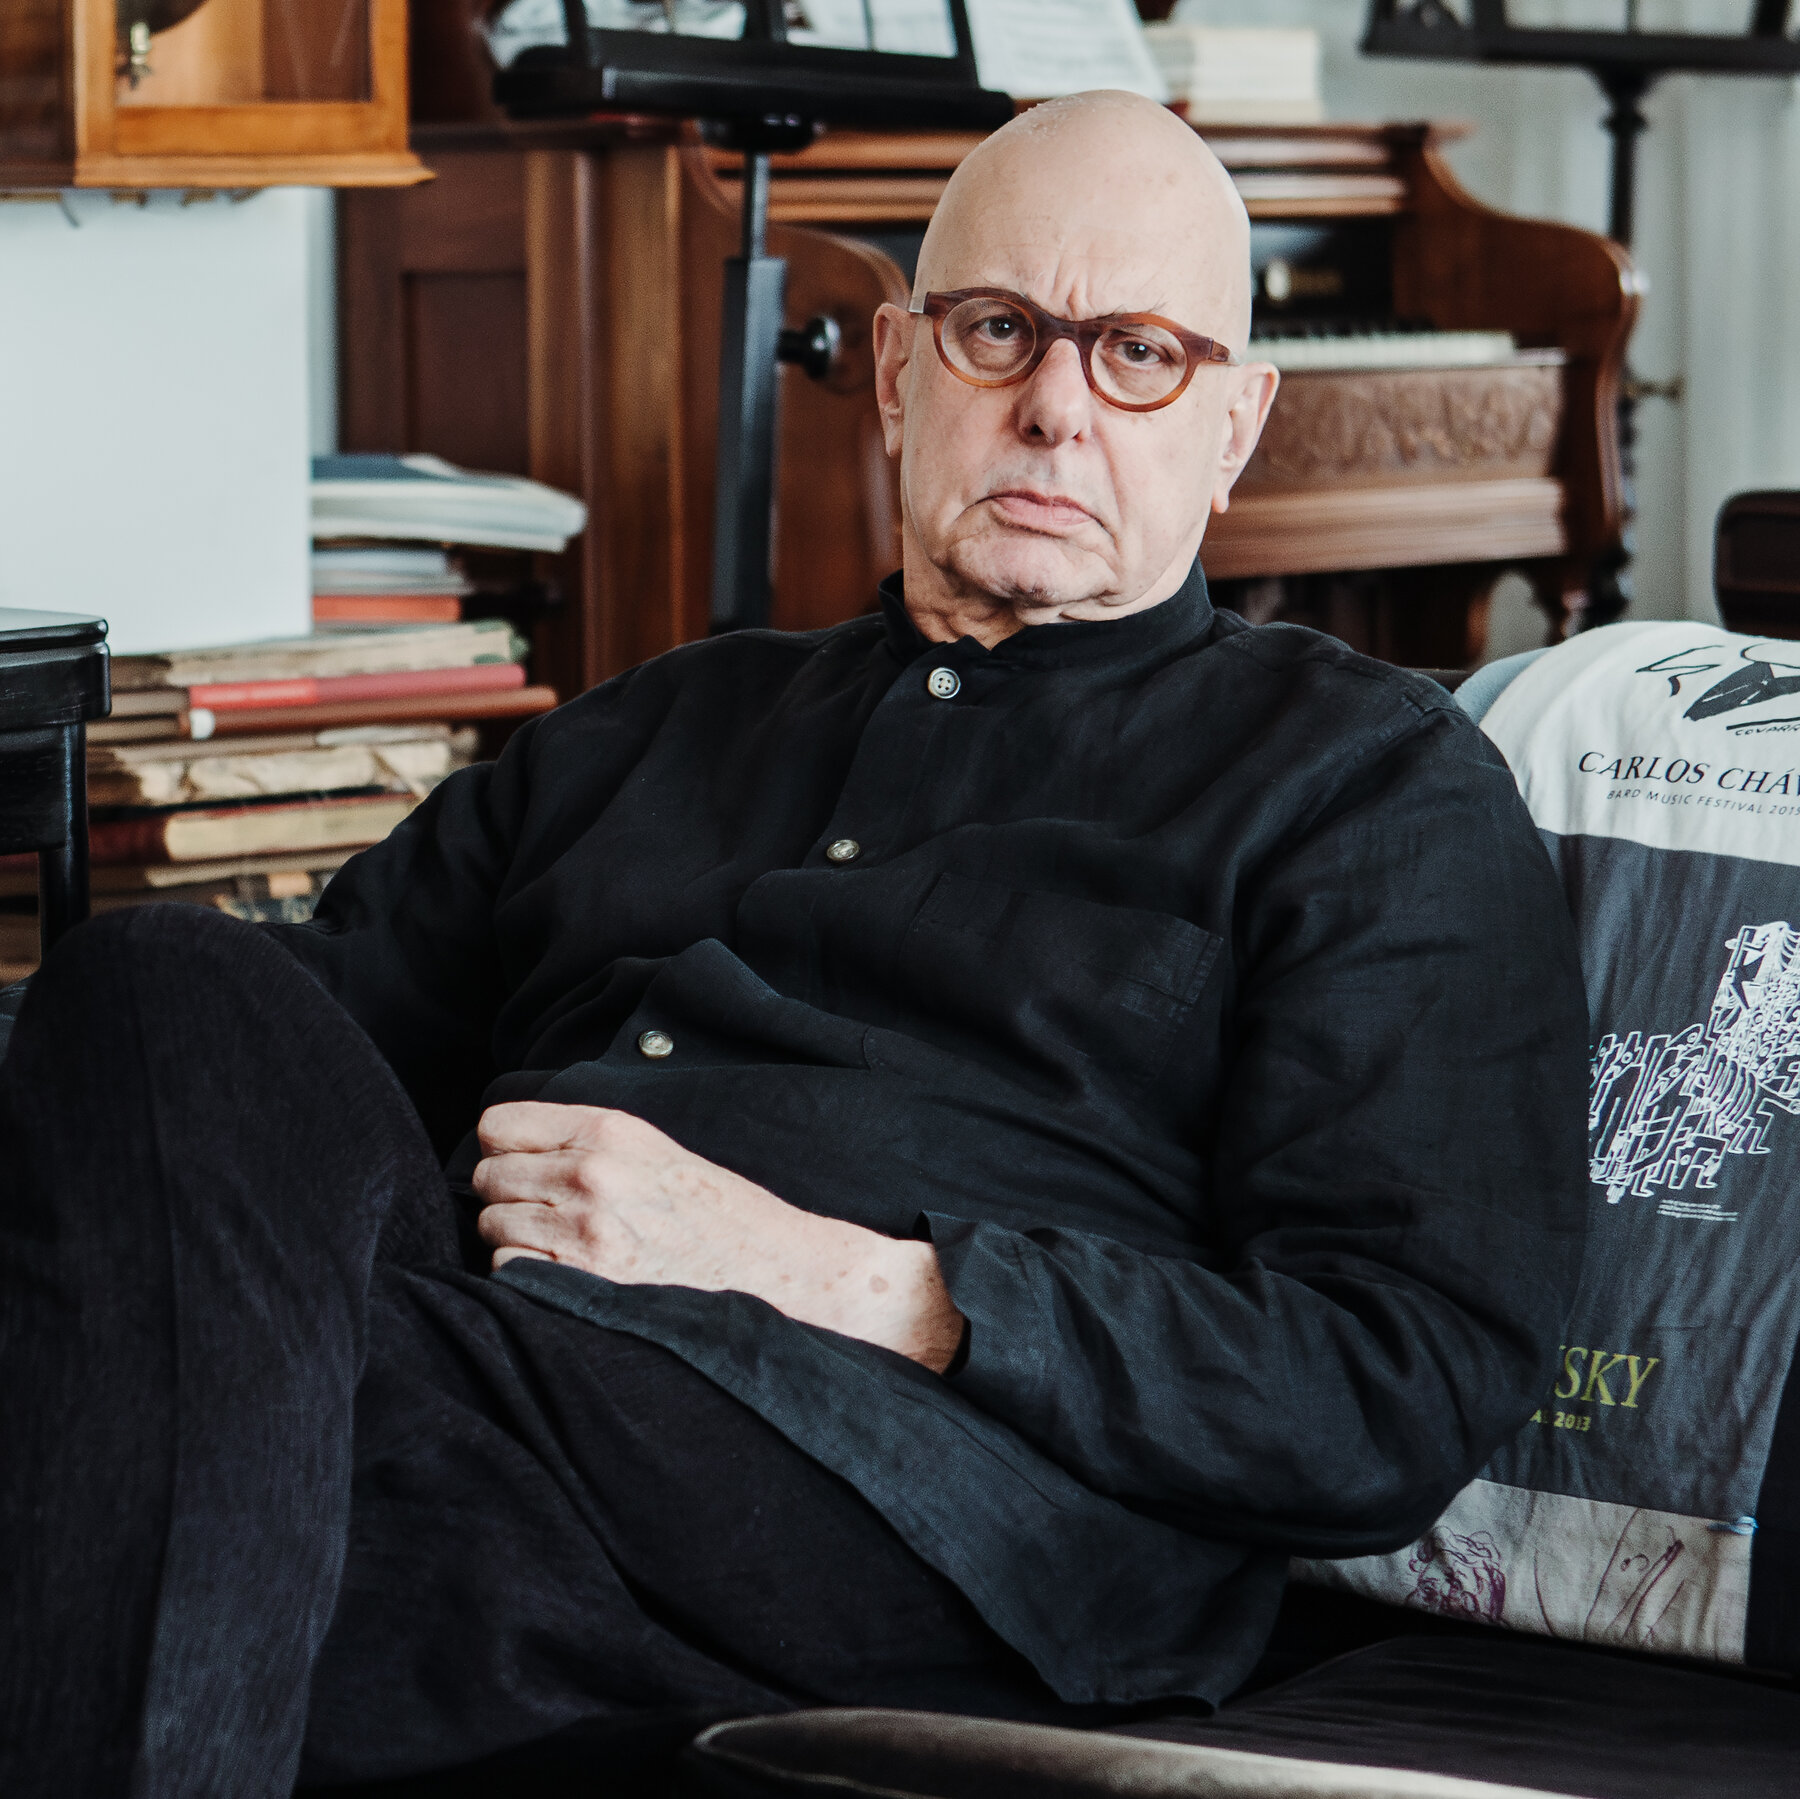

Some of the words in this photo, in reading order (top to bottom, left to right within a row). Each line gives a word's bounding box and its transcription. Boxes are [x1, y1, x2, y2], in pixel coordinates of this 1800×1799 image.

[1578, 751, 1711, 784] CARLOS
[1717, 767, 1800, 796] CHÁ
[1606, 788, 1641, 800] BARD
[1646, 790, 1692, 805] MUSIC
[1696, 795, 1763, 814] FESTIVAL
[1554, 1345, 1660, 1408] SKY
